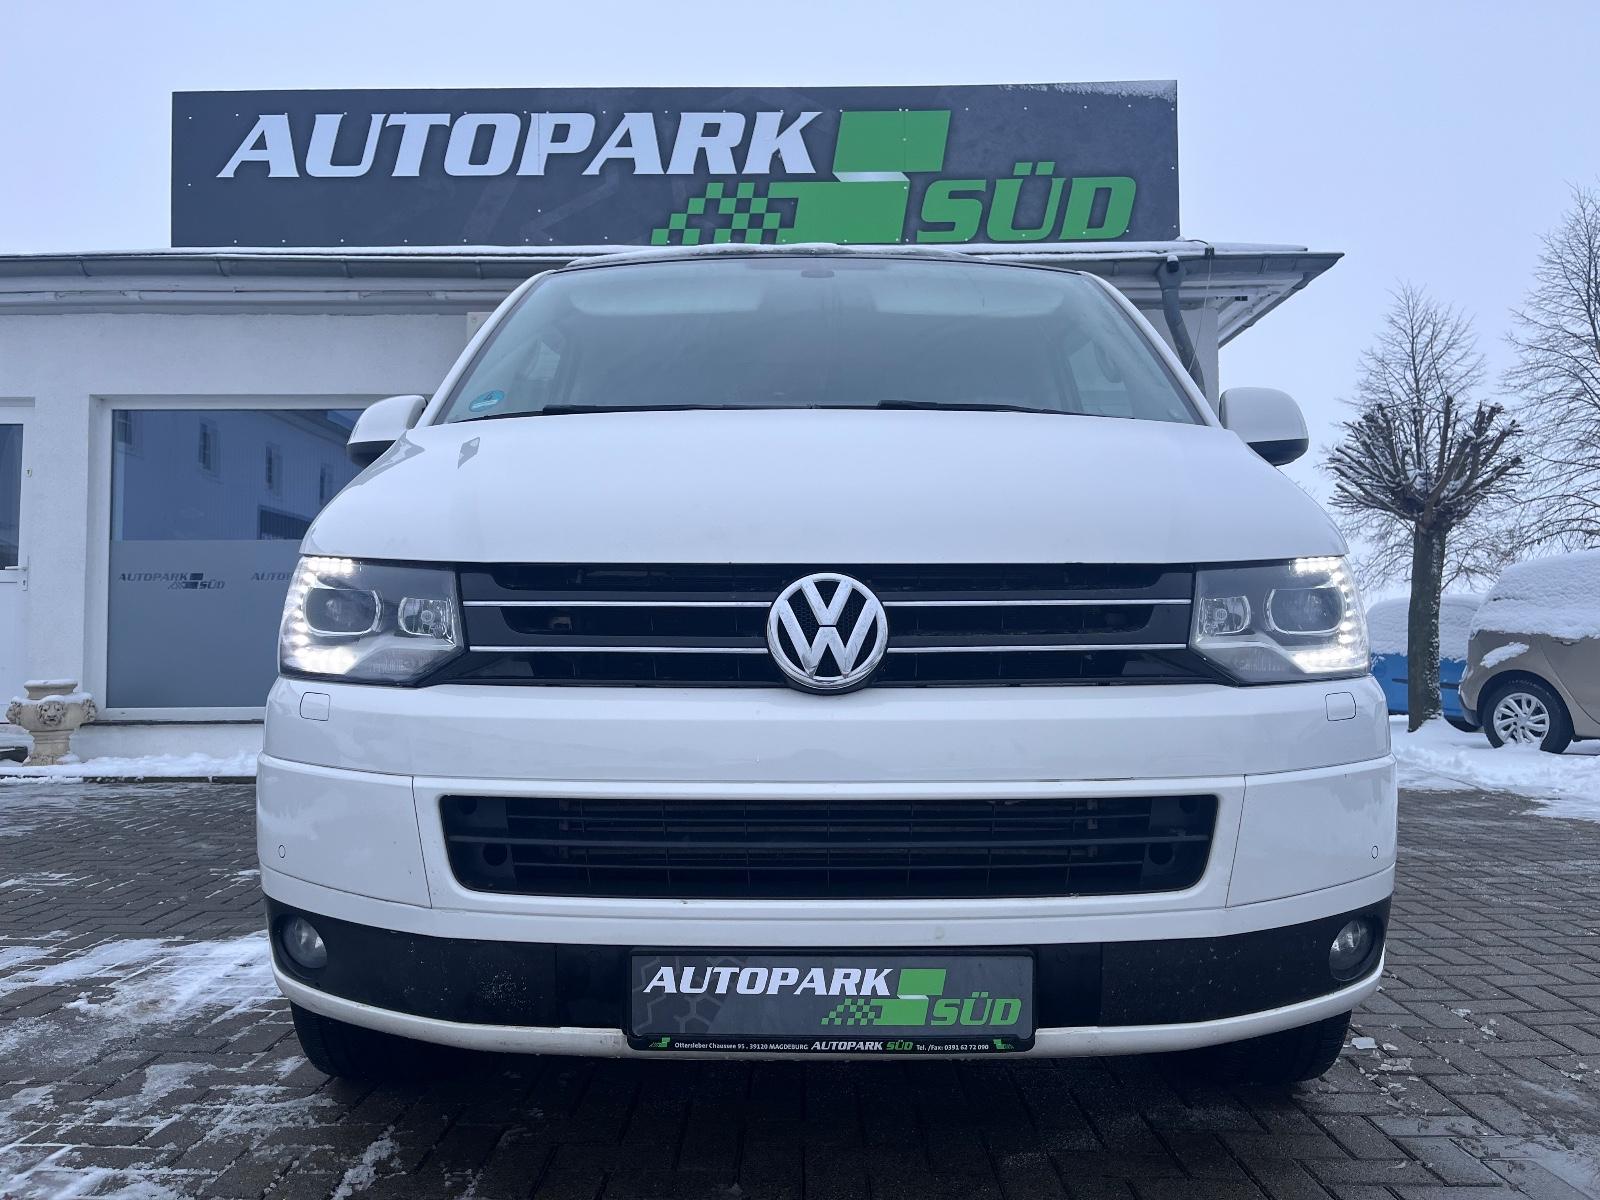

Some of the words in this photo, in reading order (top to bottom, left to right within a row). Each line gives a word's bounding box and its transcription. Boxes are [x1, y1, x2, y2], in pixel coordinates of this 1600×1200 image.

[215, 111, 823, 178] AUTOPARK
[916, 161, 1137, 243] SÜD
[118, 572, 190, 582] AUTOPARK
[199, 579, 225, 590] SÜD
[773, 575, 882, 680] VW
[642, 965, 894, 997] AUTOPARK
[930, 991, 1022, 1026] SÜD
[810, 1041, 883, 1050] AUTOPARK
[886, 1039, 914, 1050] SÜD
